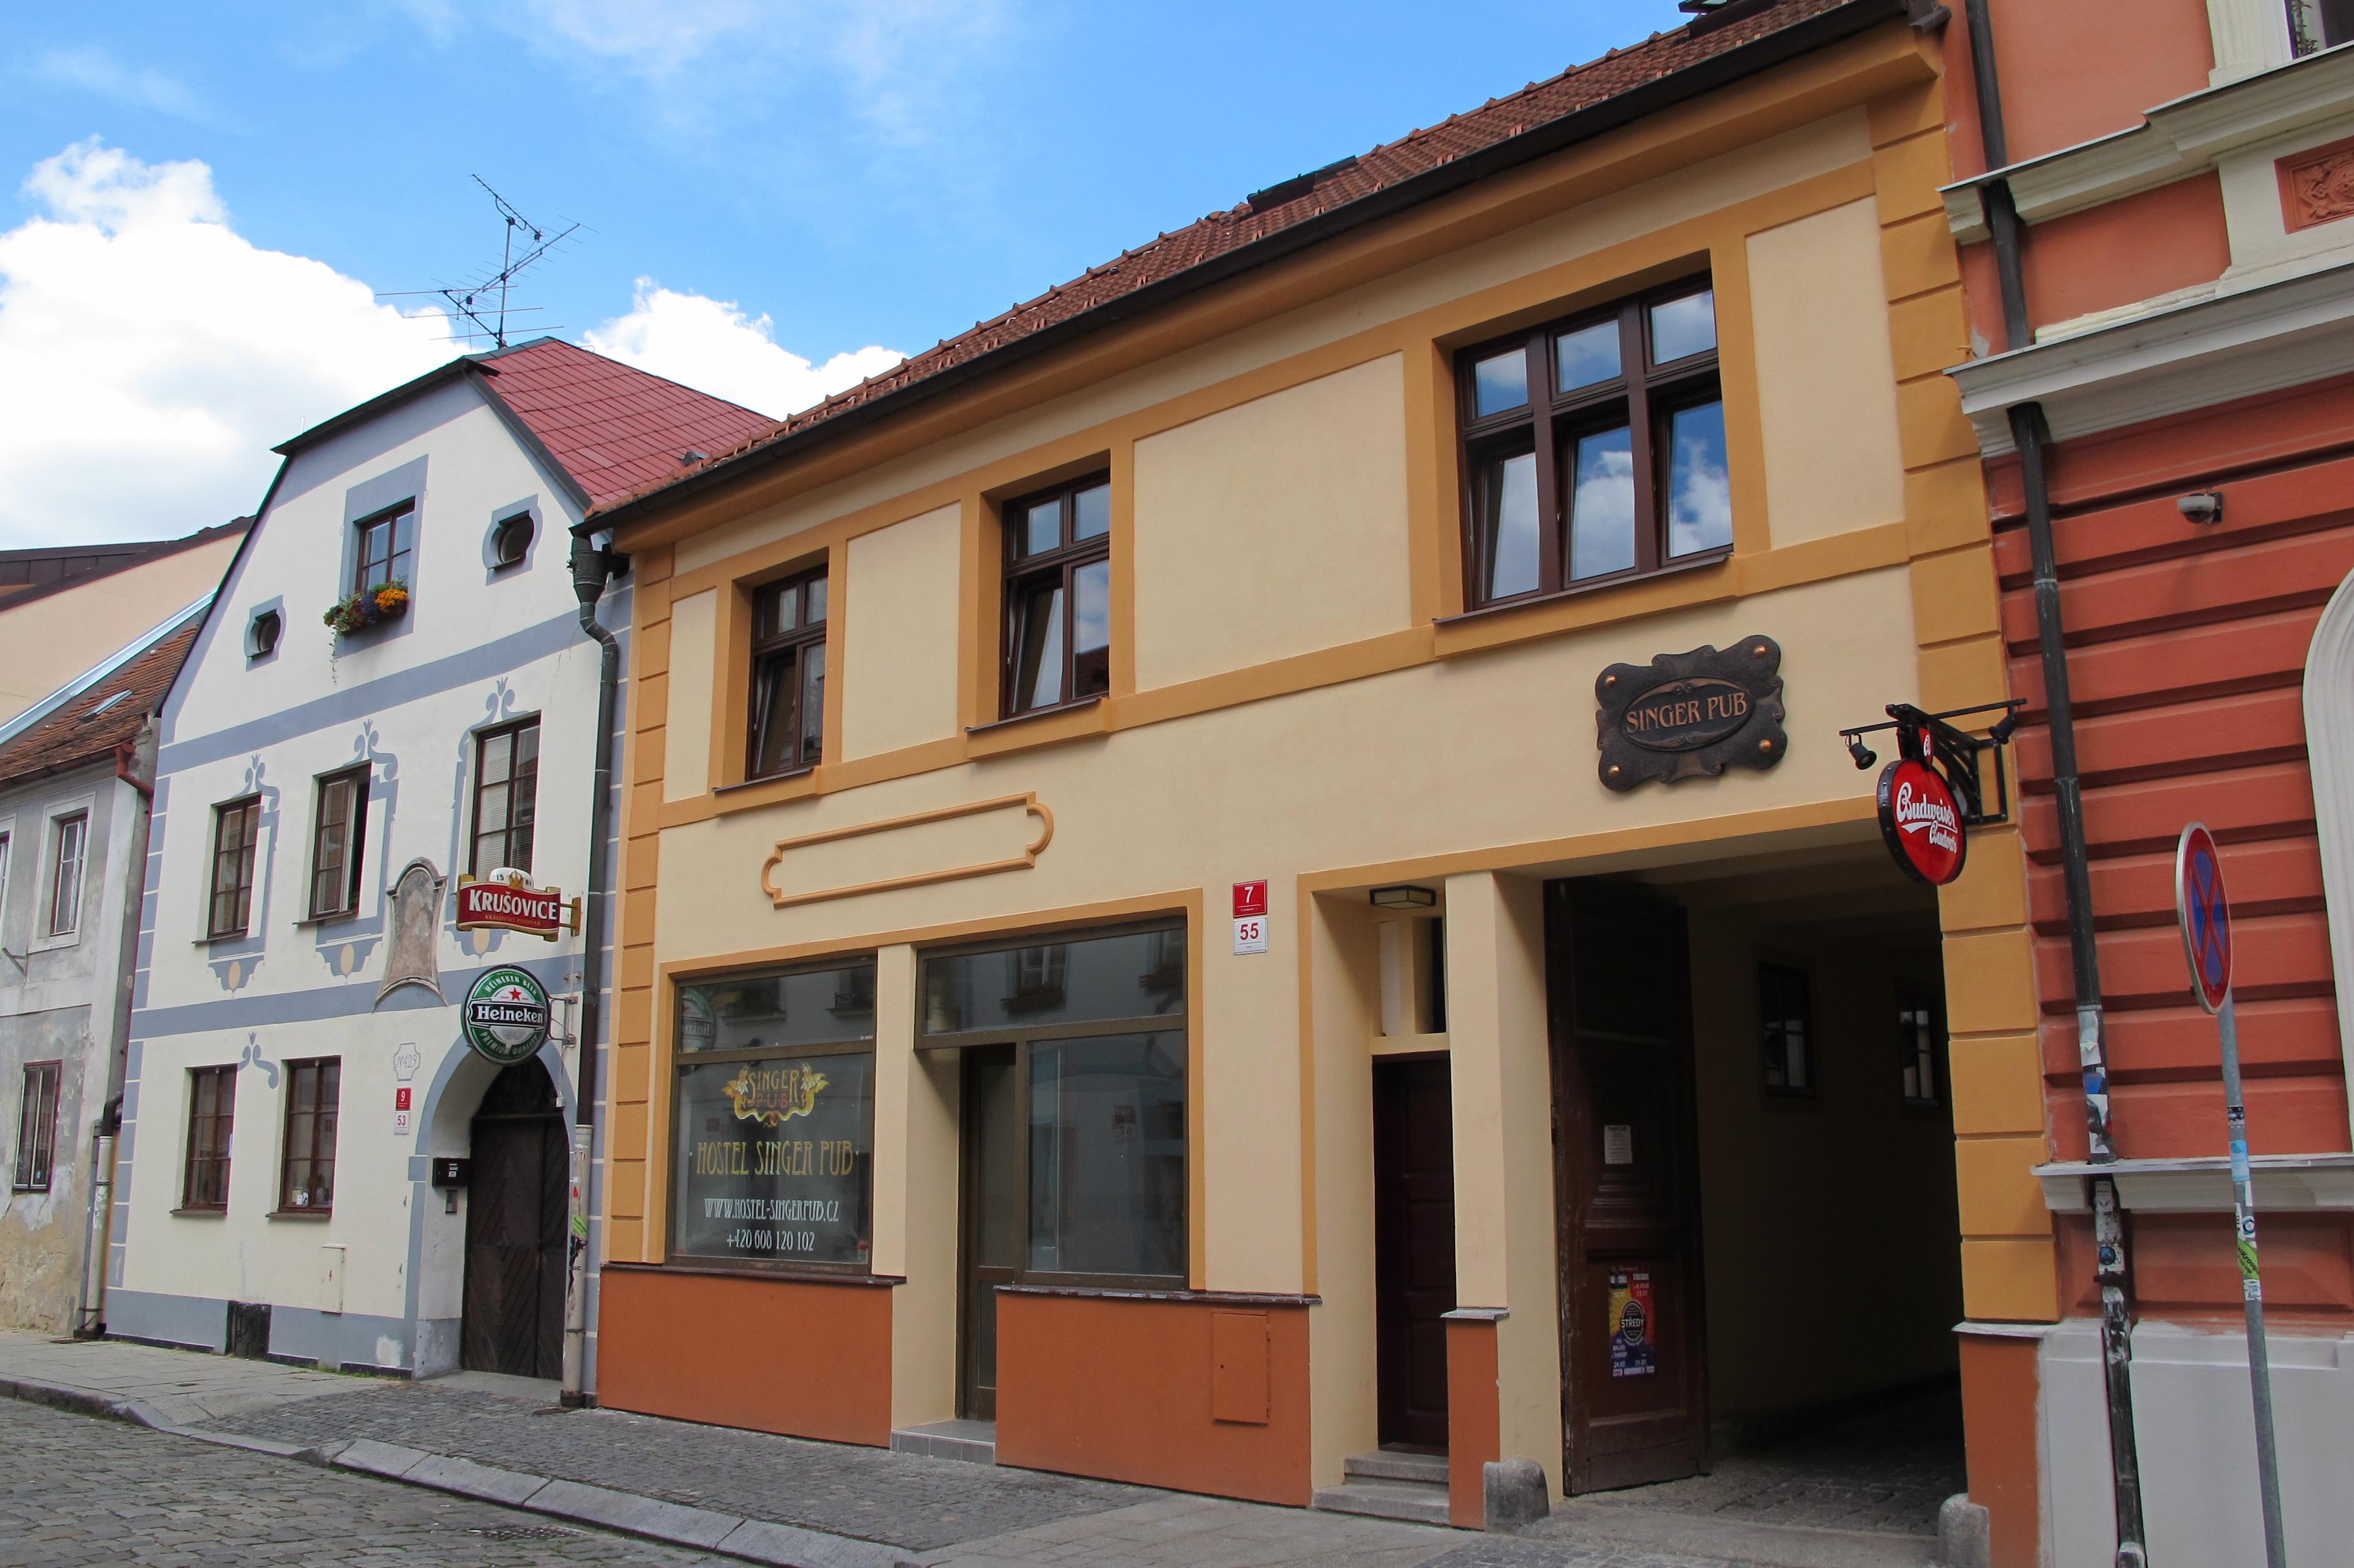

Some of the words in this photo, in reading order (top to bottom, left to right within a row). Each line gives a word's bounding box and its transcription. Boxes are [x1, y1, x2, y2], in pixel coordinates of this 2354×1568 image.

[1625, 700, 1702, 734] SINGER
[1706, 692, 1747, 721] PUB
[1896, 781, 1957, 830] Budweiser
[469, 889, 558, 920] KRUŠOVICE
[1244, 885, 1254, 903] 7
[1239, 922, 1259, 940] 55
[484, 975, 520, 992] HEINEKEN
[476, 1005, 544, 1023] Heineken
[479, 1031, 510, 1054] PREMIUM
[400, 1090, 406, 1102] 9
[748, 1069, 800, 1105] SINGER
[397, 1114, 407, 1126] 53
[696, 1141, 749, 1175] HOSTEL
[754, 1140, 814, 1176] SINGER
[819, 1140, 854, 1176] PUB
[704, 1197, 840, 1223] WWW.HOSTEL-SINGERPUB.CZ
[727, 1228, 752, 1249] +420
[754, 1229, 772, 1250] 608
[776, 1230, 794, 1251] 120
[797, 1231, 816, 1252] 102
[1621, 1316, 1644, 1329] STŘEDY
